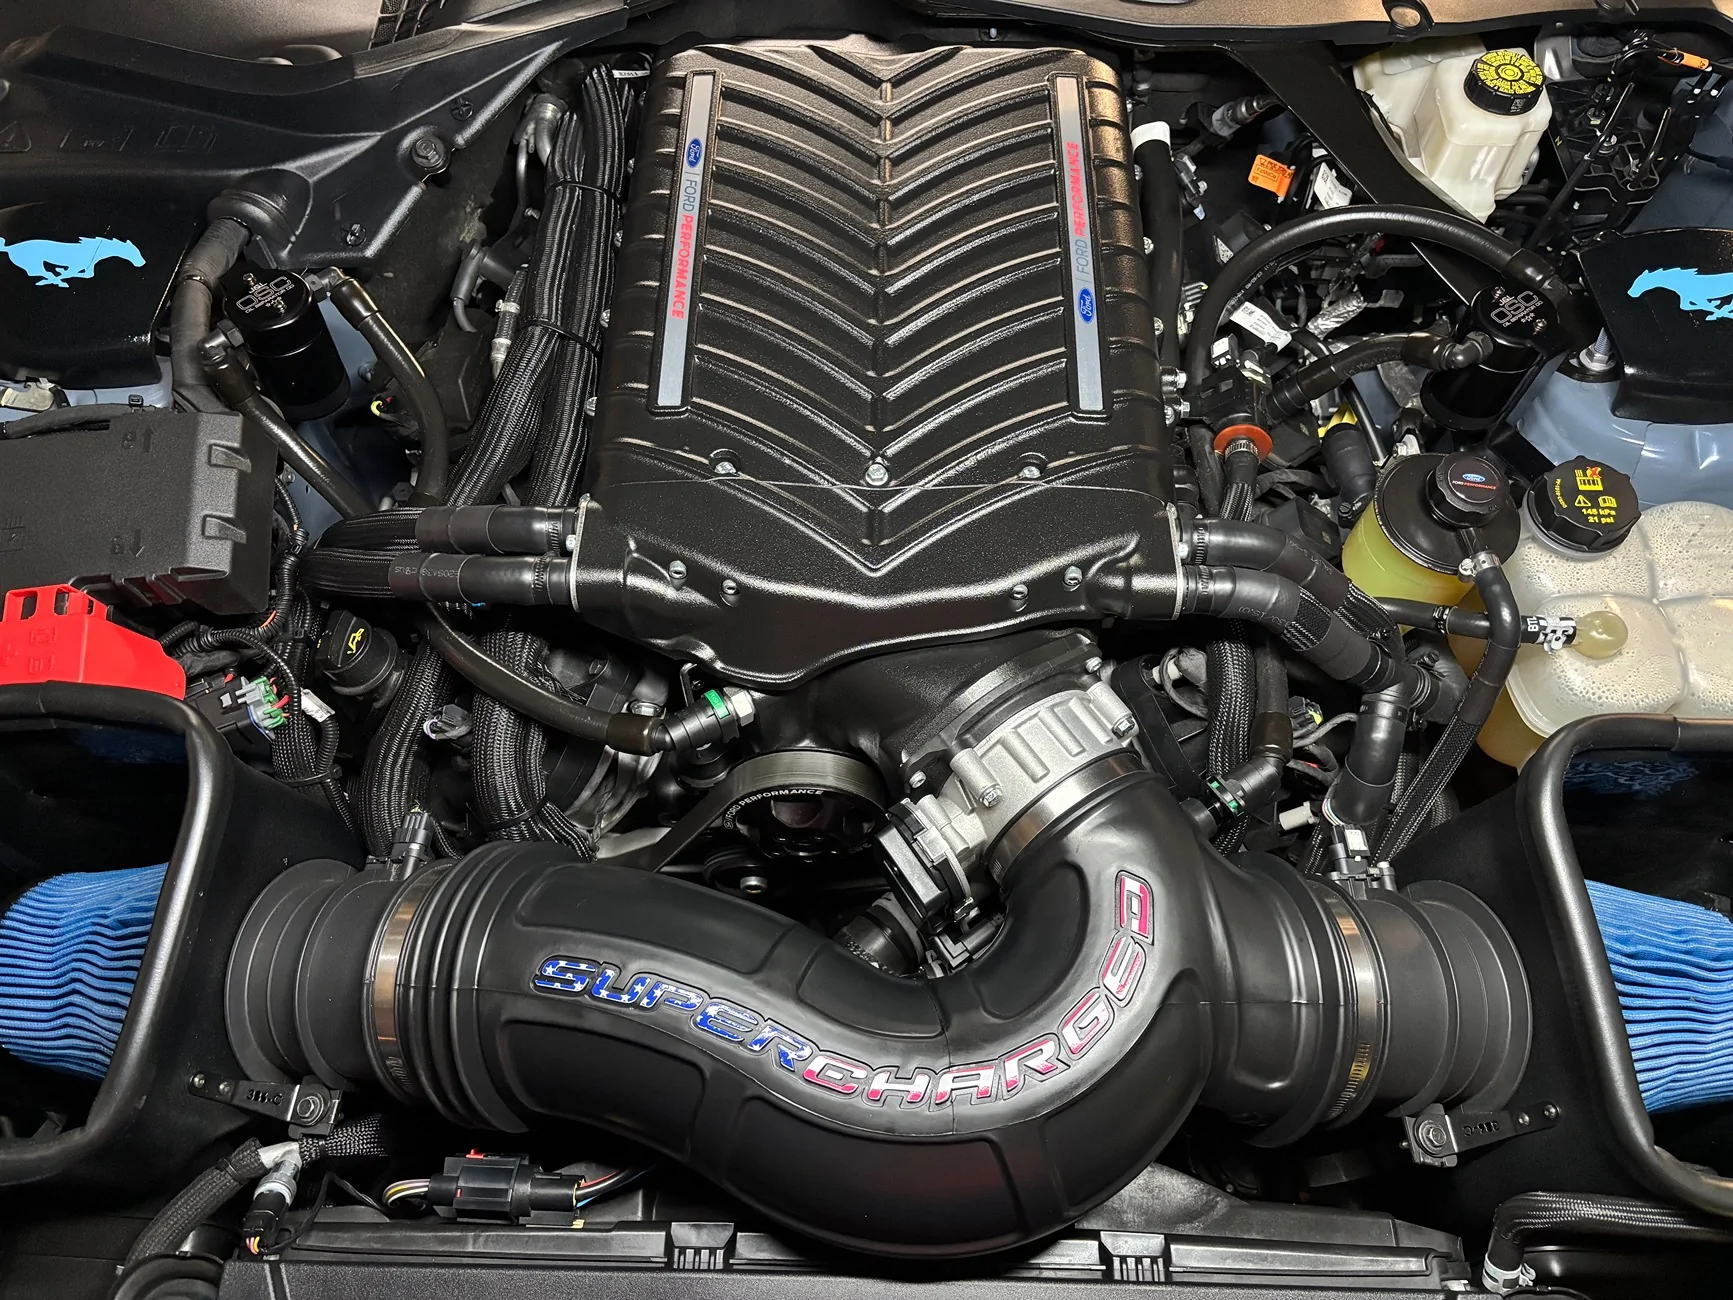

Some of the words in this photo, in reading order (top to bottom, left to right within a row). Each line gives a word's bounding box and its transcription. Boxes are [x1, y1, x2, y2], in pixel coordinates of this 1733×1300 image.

[683, 179, 697, 212] FORD
[1066, 142, 1086, 237] PERFORMANCE
[672, 213, 694, 319] PERFORMANCE
[1075, 239, 1089, 275] FORD
[1601, 516, 1615, 524] psi
[740, 789, 824, 806] PERFORMANCE
[533, 872, 1153, 1106] SUPERCHARGED
